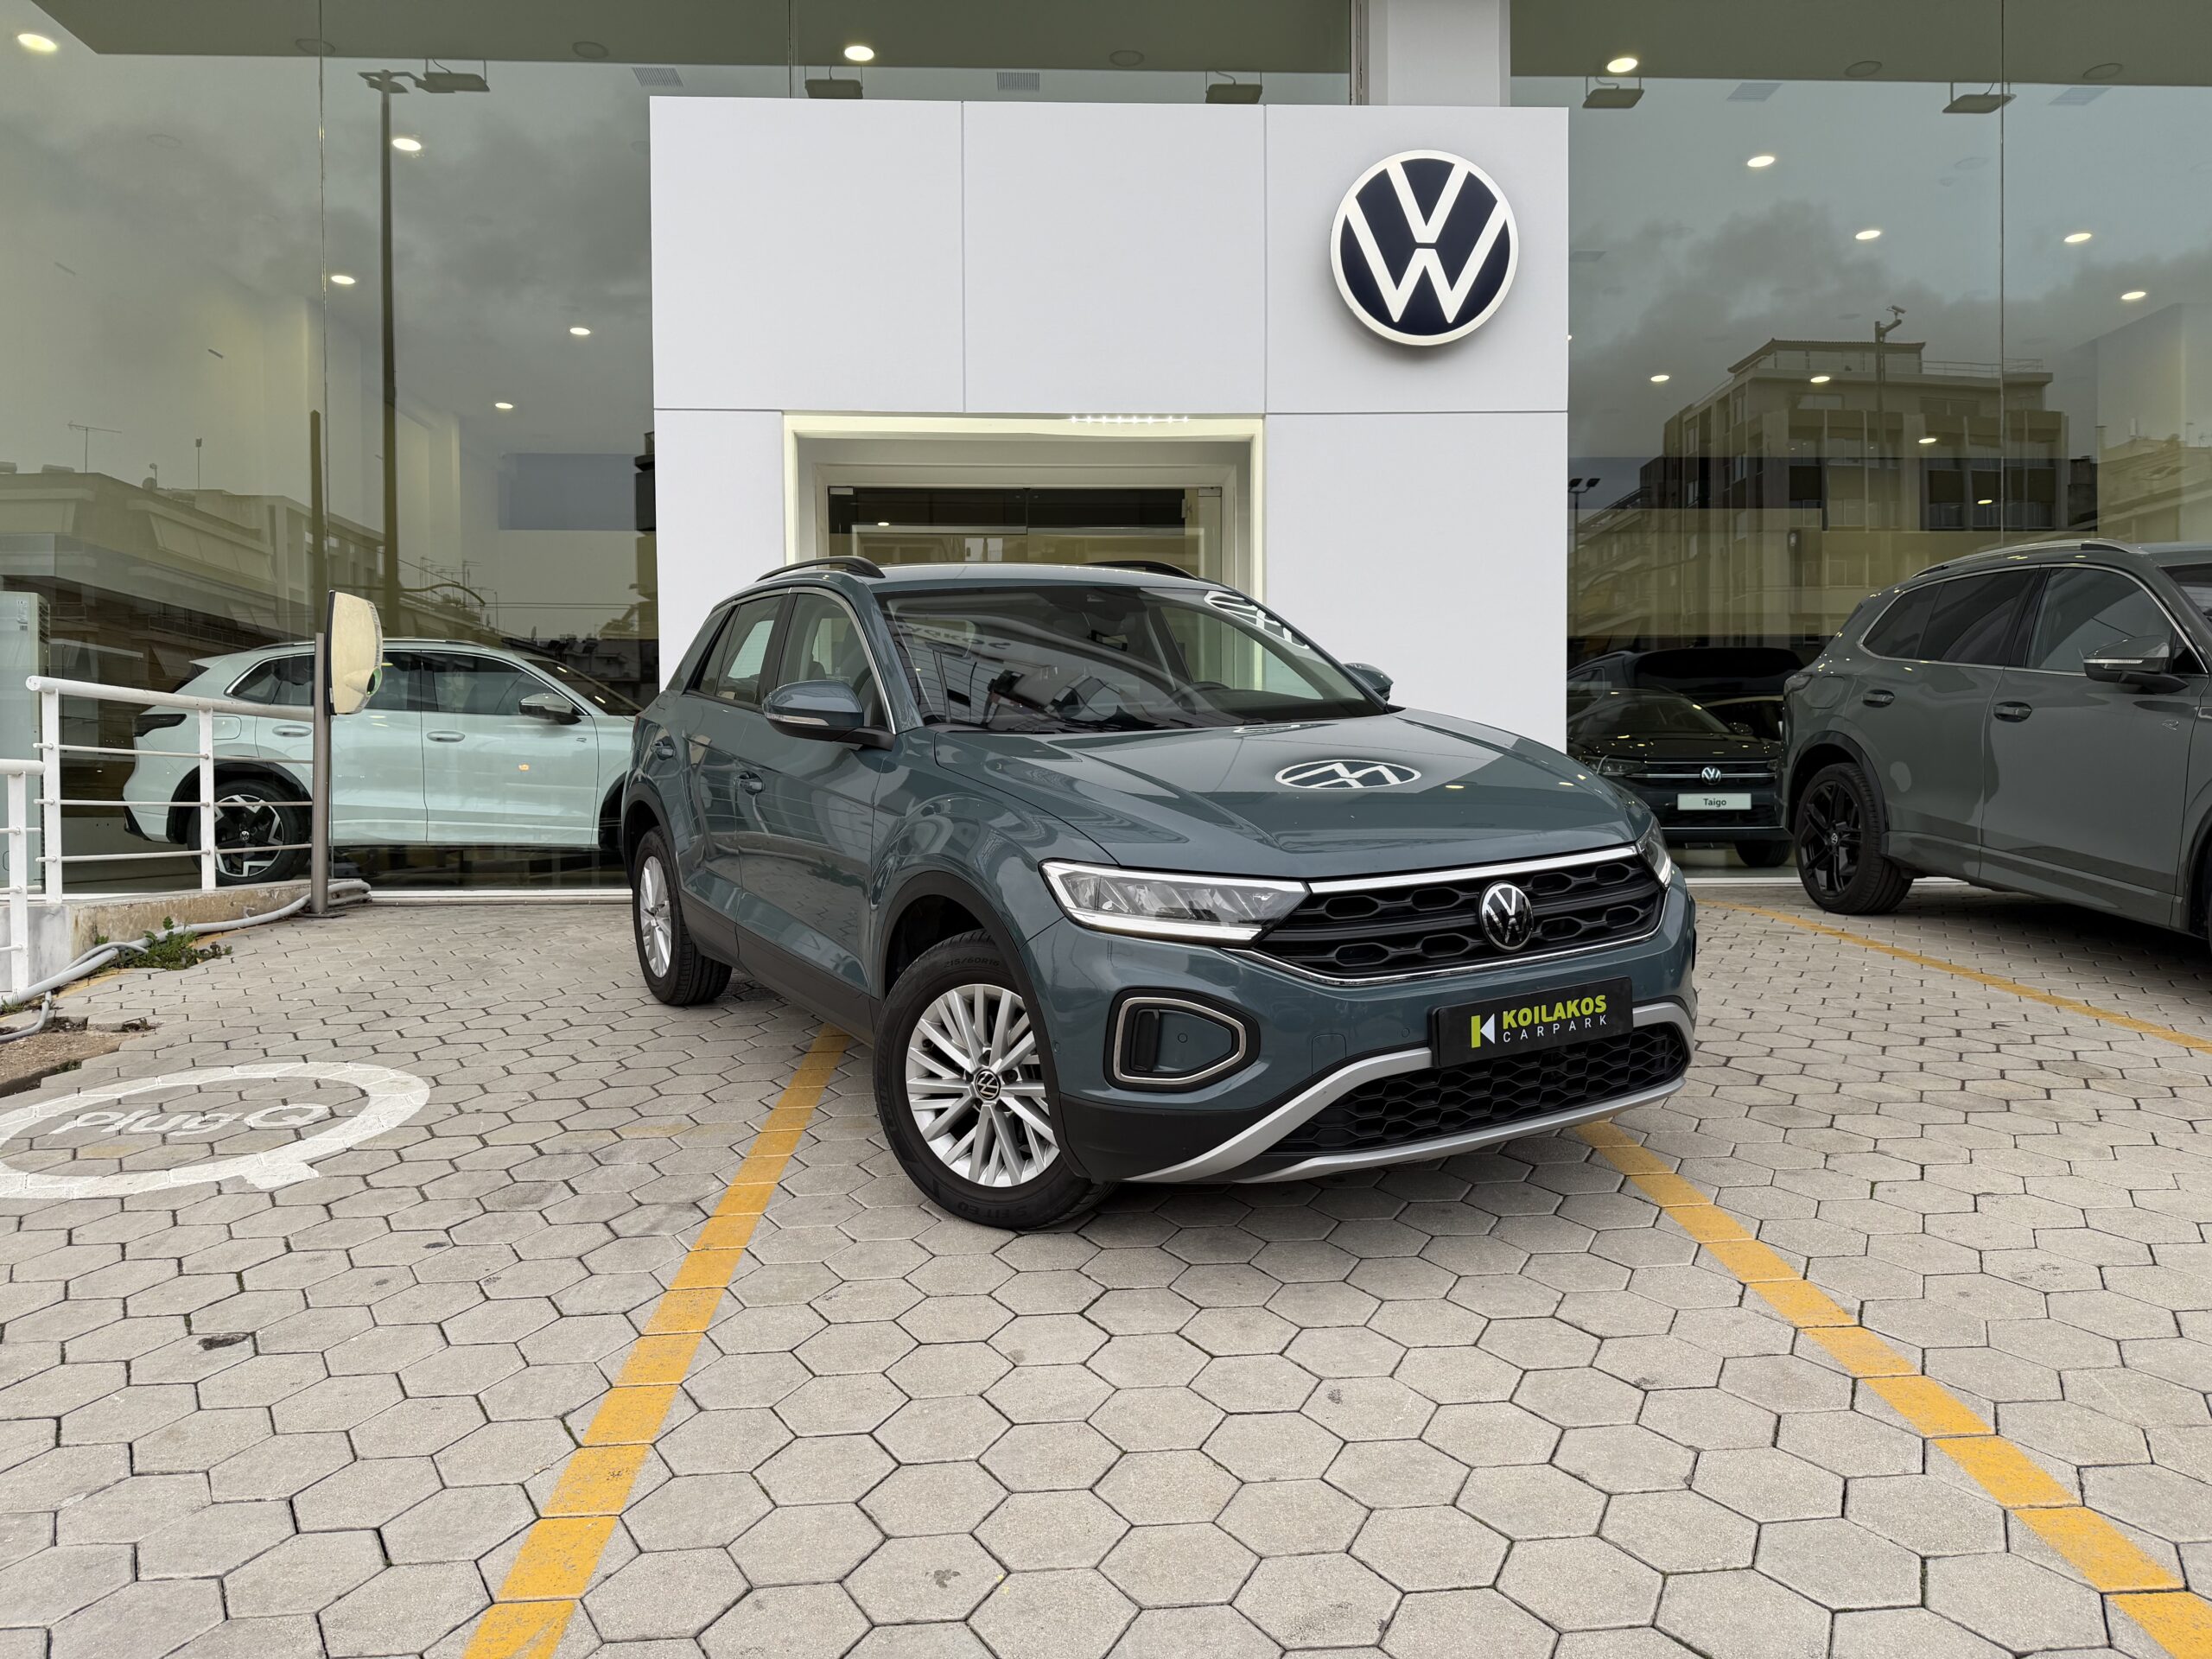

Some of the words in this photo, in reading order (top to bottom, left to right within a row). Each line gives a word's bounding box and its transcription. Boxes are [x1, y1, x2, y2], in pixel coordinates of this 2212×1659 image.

[1336, 154, 1514, 337] VW
[1703, 798, 1727, 807] Taigo
[944, 957, 1001, 968] 215/60R16
[1503, 995, 1607, 1030] KOILAKOS
